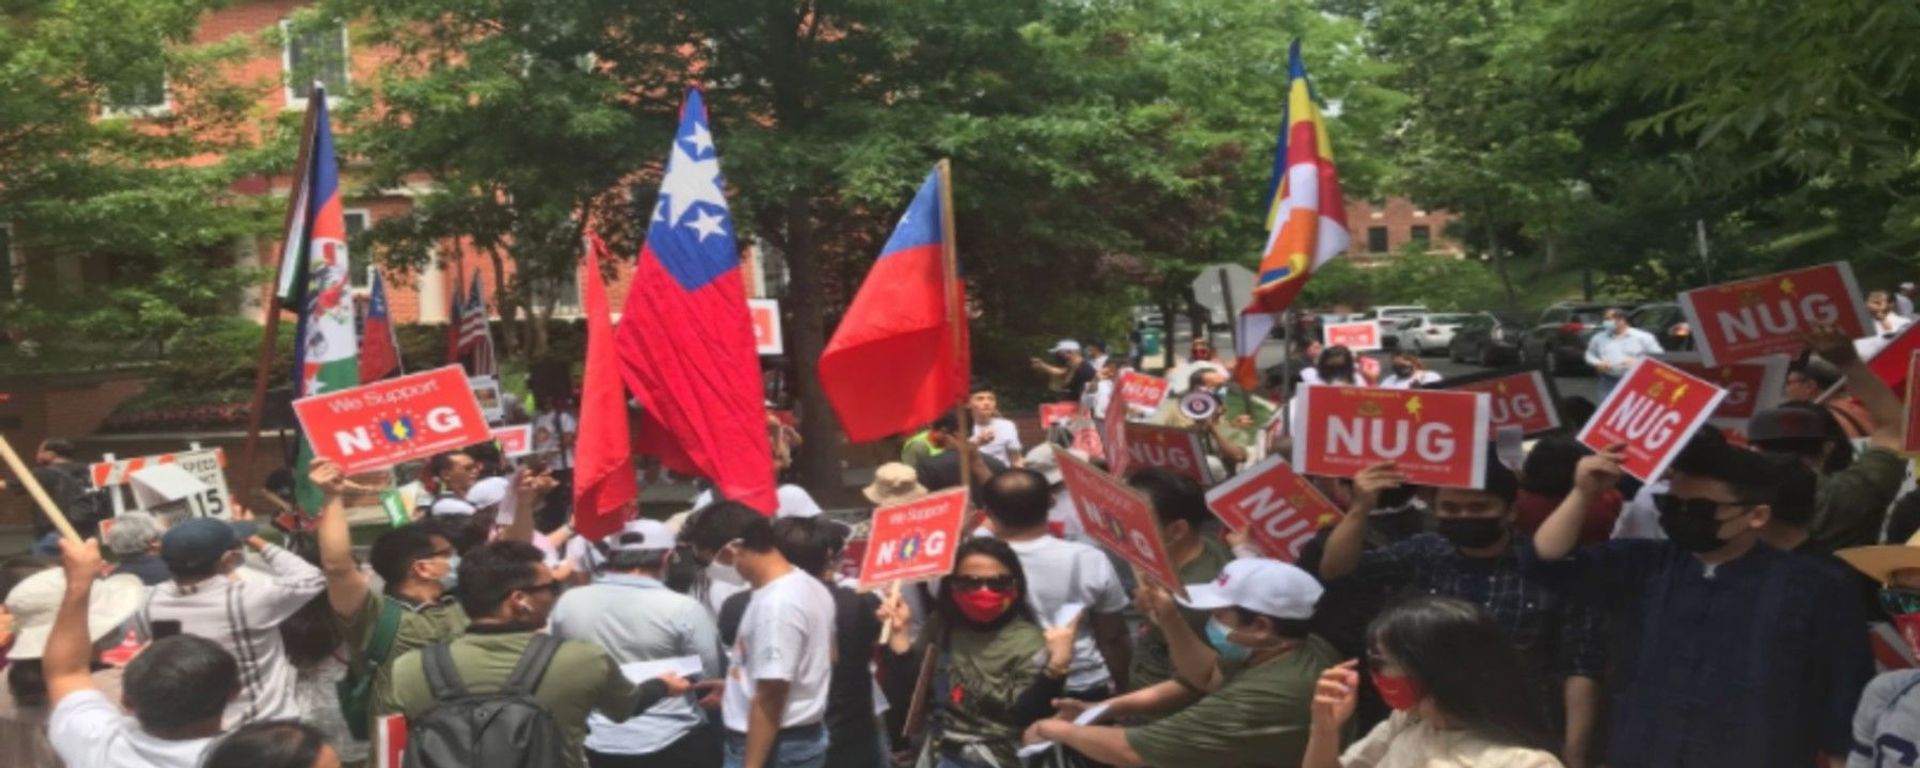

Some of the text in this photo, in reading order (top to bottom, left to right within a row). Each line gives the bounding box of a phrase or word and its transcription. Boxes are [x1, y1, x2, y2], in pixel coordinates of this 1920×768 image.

[1716, 293, 1840, 344] NUG
[328, 378, 439, 414] We Support
[1121, 380, 1161, 399] NUG
[1489, 393, 1537, 423] UG
[1605, 390, 1681, 450] NUG
[1325, 414, 1456, 463] NUG
[195, 488, 224, 519] 15
